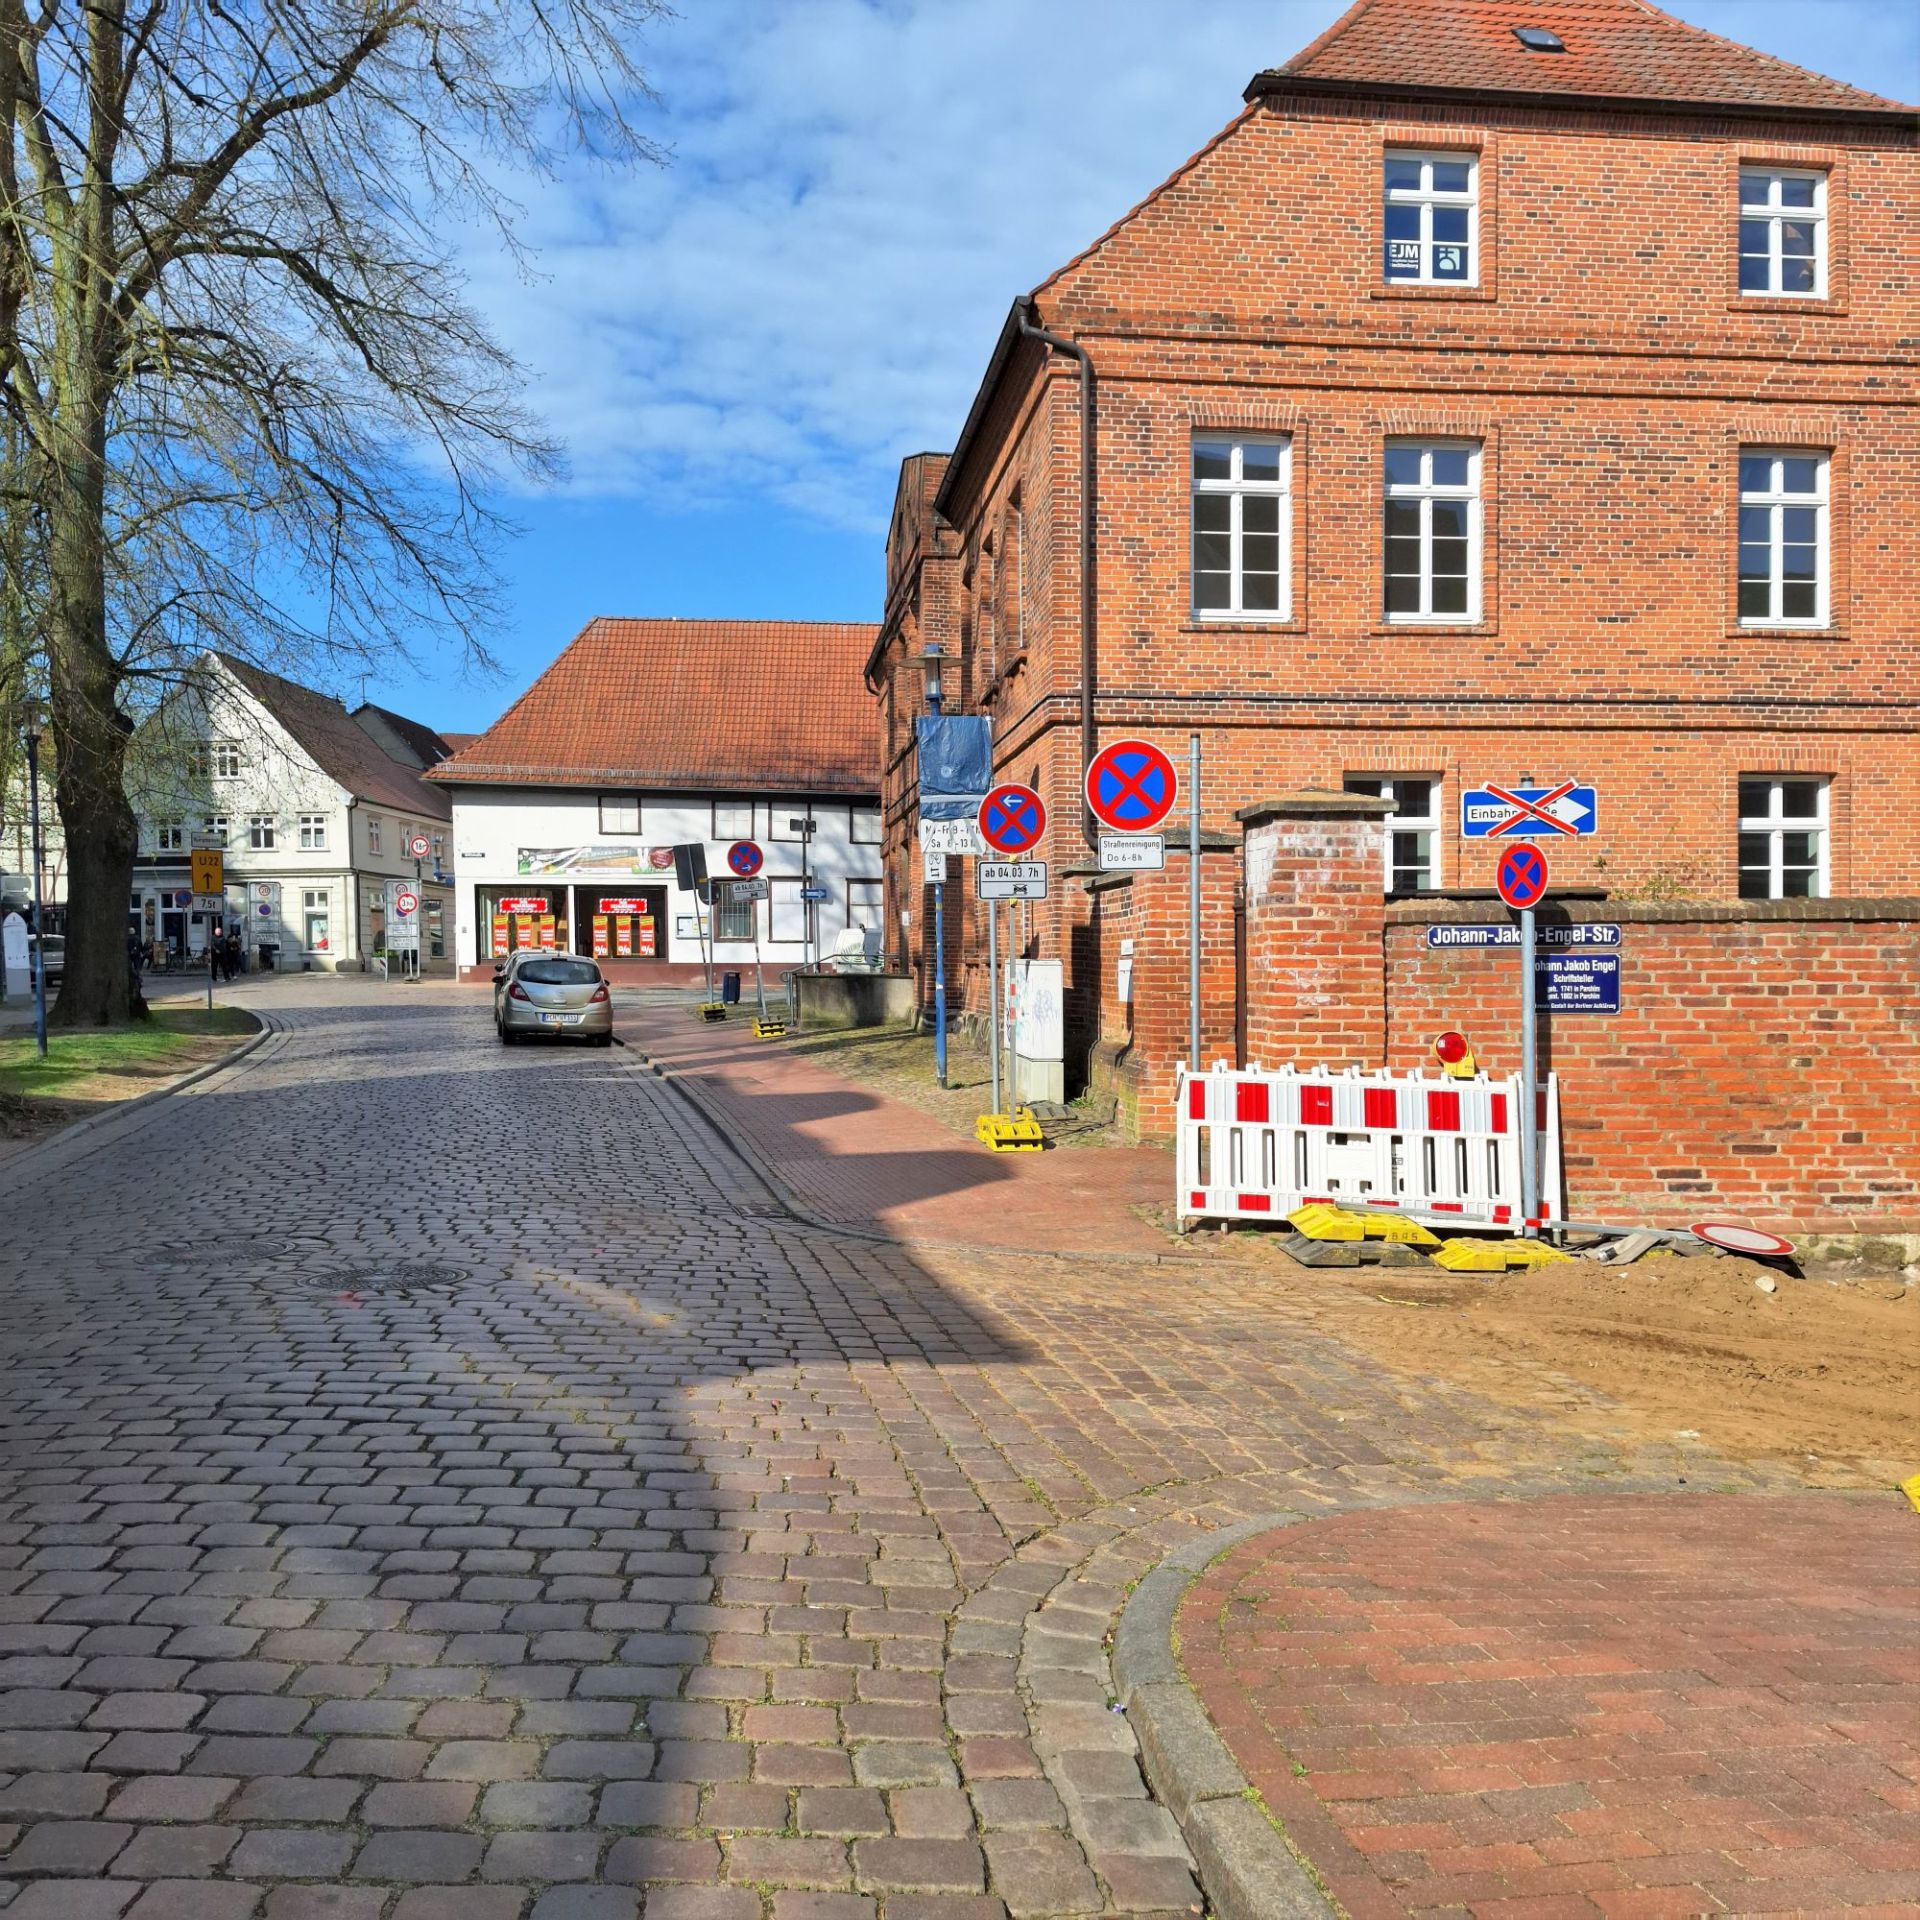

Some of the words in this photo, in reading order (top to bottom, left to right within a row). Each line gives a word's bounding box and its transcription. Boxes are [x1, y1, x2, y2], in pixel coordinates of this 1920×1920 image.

[1389, 244, 1419, 258] EJM
[931, 839, 941, 848] Sa
[1103, 840, 1160, 849] Straßenreinigung
[199, 856, 220, 866] U22
[1107, 853, 1119, 862] Do
[985, 867, 995, 878] ab
[998, 867, 1025, 878] 04.03.
[1028, 867, 1039, 878] 7h
[1432, 926, 1616, 945] Johann-Jak-Engel-Str.
[1534, 960, 1562, 971] ohann
[1563, 960, 1591, 971] Jakob
[1592, 959, 1617, 974] Engel
[1553, 974, 1595, 983] Schriftsteller
